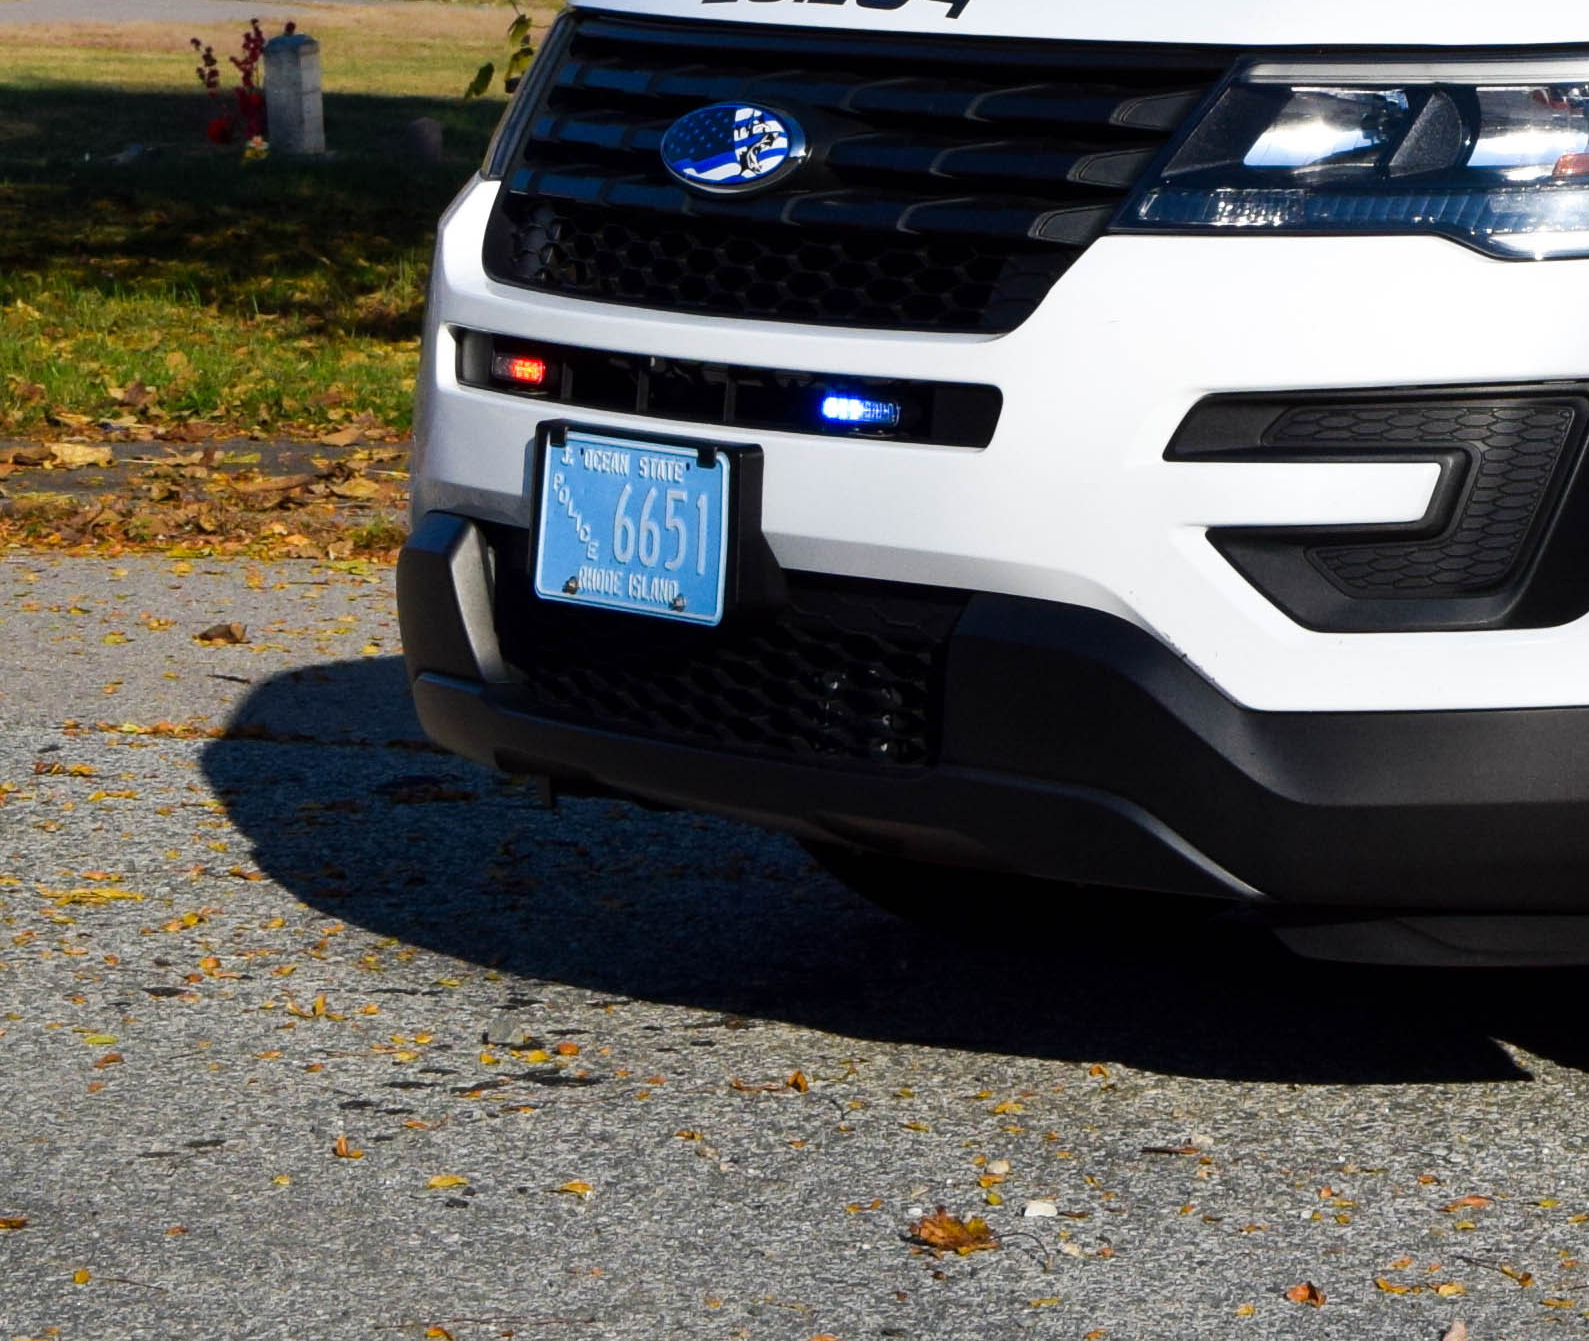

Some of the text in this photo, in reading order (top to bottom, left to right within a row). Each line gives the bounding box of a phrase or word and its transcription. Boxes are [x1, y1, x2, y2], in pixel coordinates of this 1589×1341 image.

[584, 447, 631, 477] OCEAN
[639, 456, 685, 484] STATE
[552, 470, 600, 560] POLICE
[612, 482, 709, 576] 6651
[578, 564, 680, 604] RHODE ISLAND
